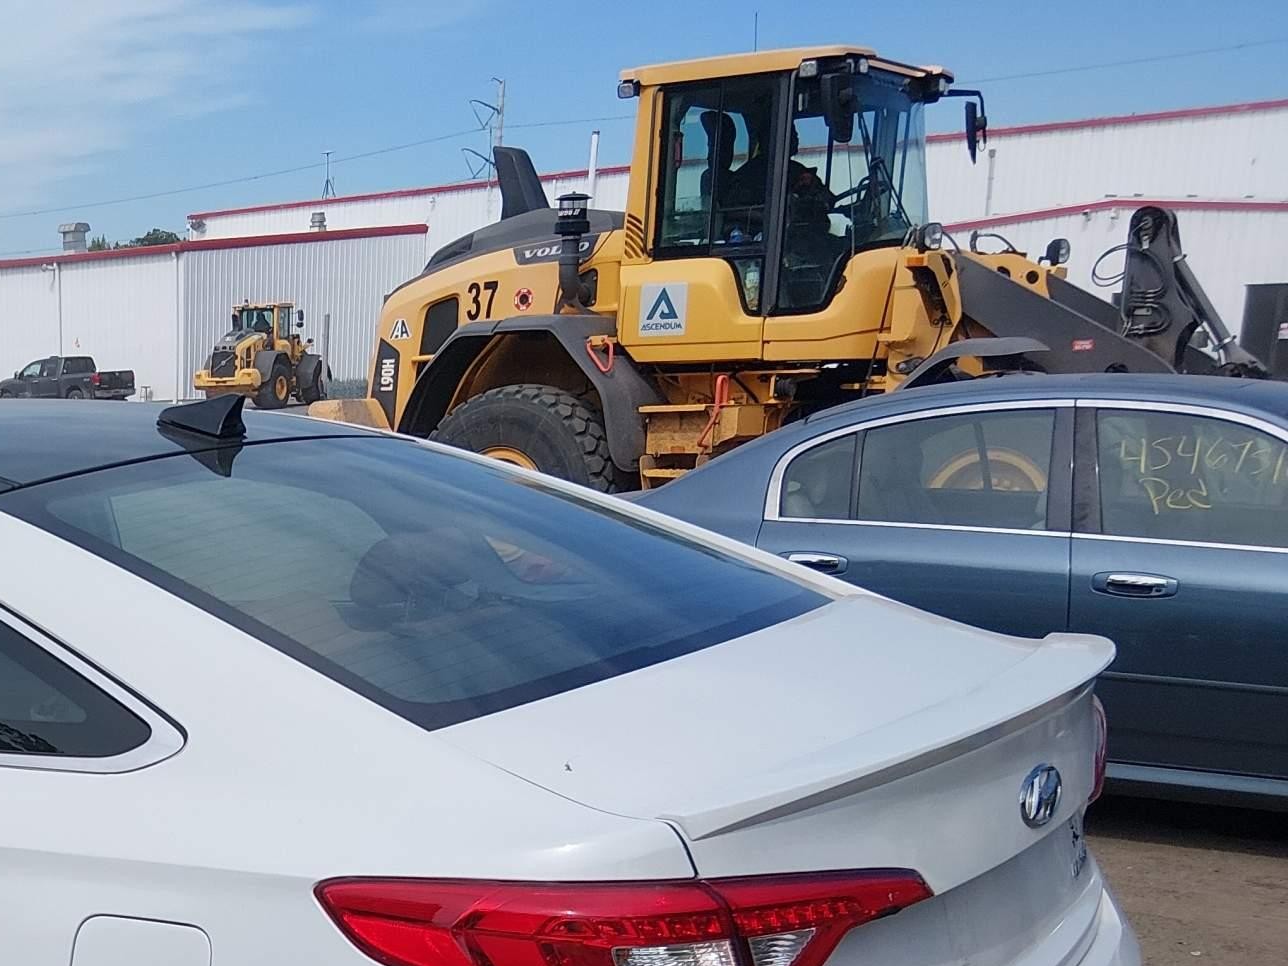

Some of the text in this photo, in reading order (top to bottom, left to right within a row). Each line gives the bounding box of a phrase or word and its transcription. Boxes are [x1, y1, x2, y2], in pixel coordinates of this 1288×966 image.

[523, 241, 590, 259] VOLO
[466, 280, 499, 321] 37
[640, 322, 683, 331] ASCENDUM
[380, 358, 396, 392] L90H
[1119, 435, 1288, 485] 4546731
